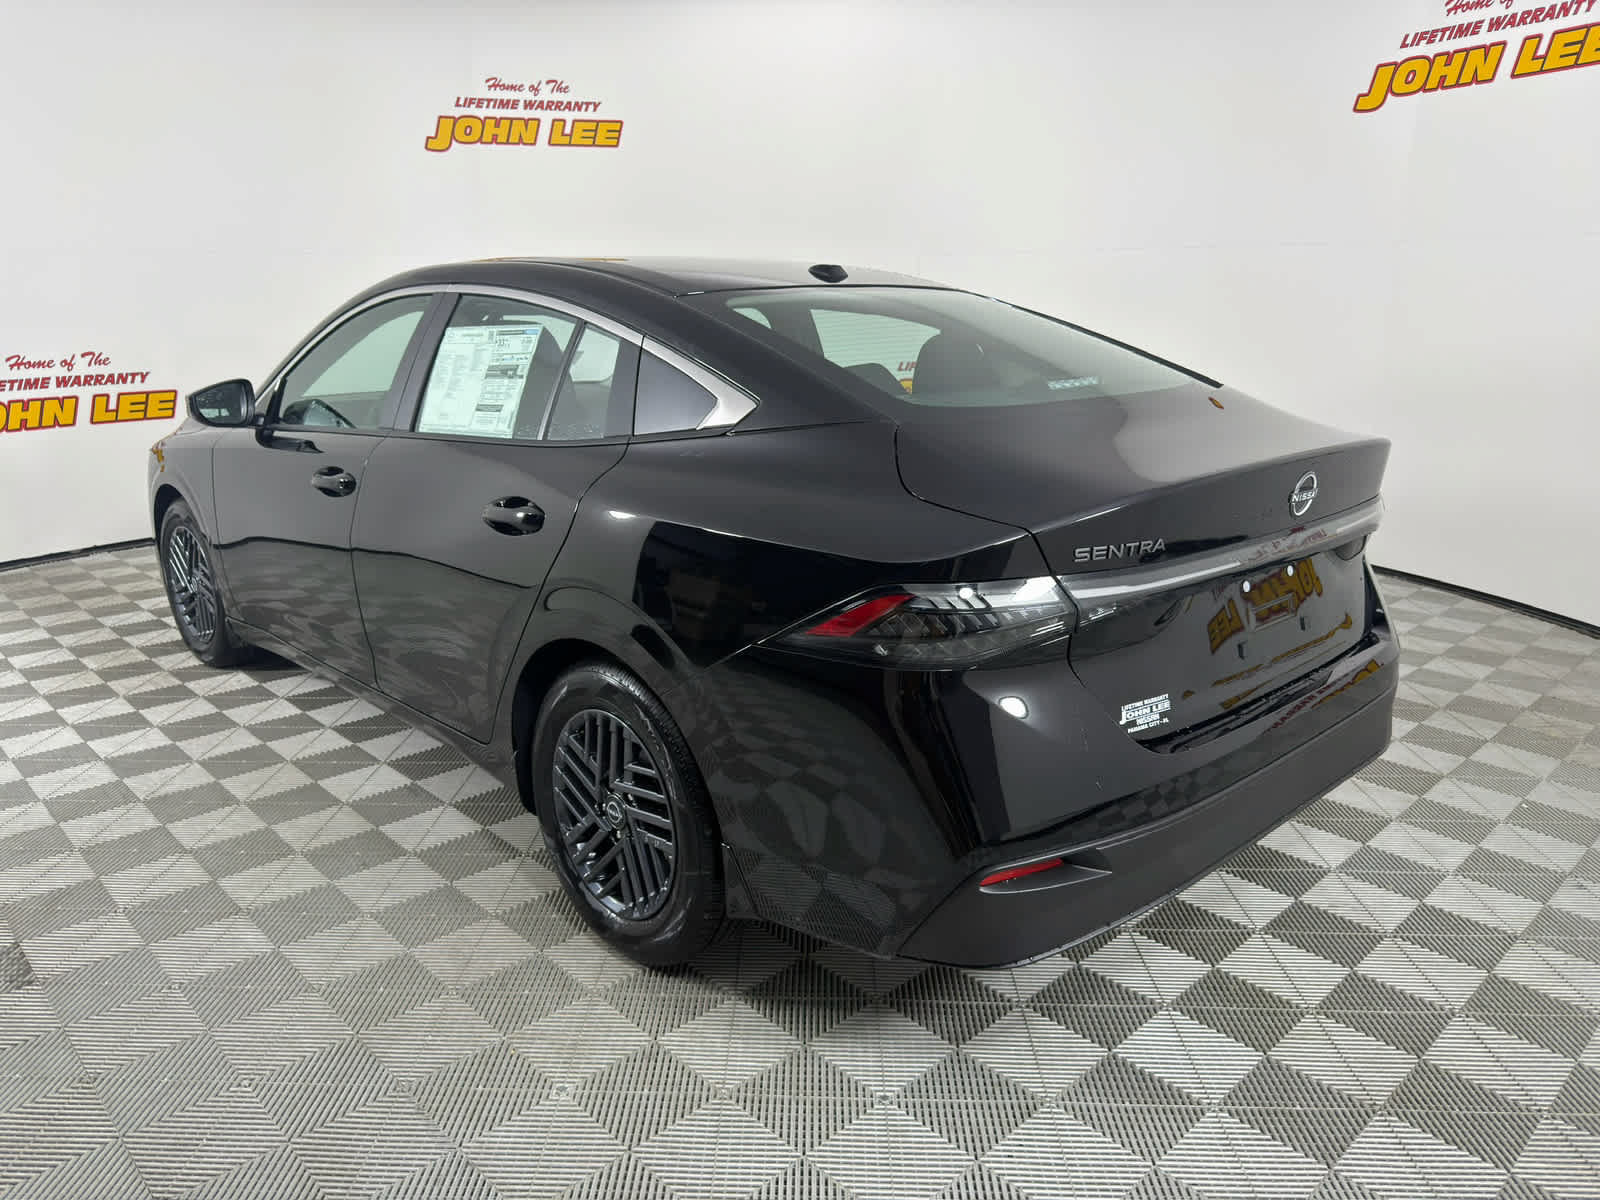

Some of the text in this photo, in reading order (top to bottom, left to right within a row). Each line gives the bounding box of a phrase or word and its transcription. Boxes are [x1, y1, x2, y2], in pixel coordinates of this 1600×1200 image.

[1400, 0, 1599, 49] LIFETIME WARRANTY
[485, 77, 570, 97] Home of The
[1353, 40, 1508, 112] JOHN
[454, 96, 601, 112] LIFETIME WARRANTY
[425, 115, 623, 152] JOHN LEE
[5, 351, 112, 371] Home of The
[55, 371, 151, 388] WARRANTY
[0, 389, 178, 433] HN LEE
[1074, 538, 1166, 562] SENTRA
[1119, 700, 1171, 725] JOHN LEE
